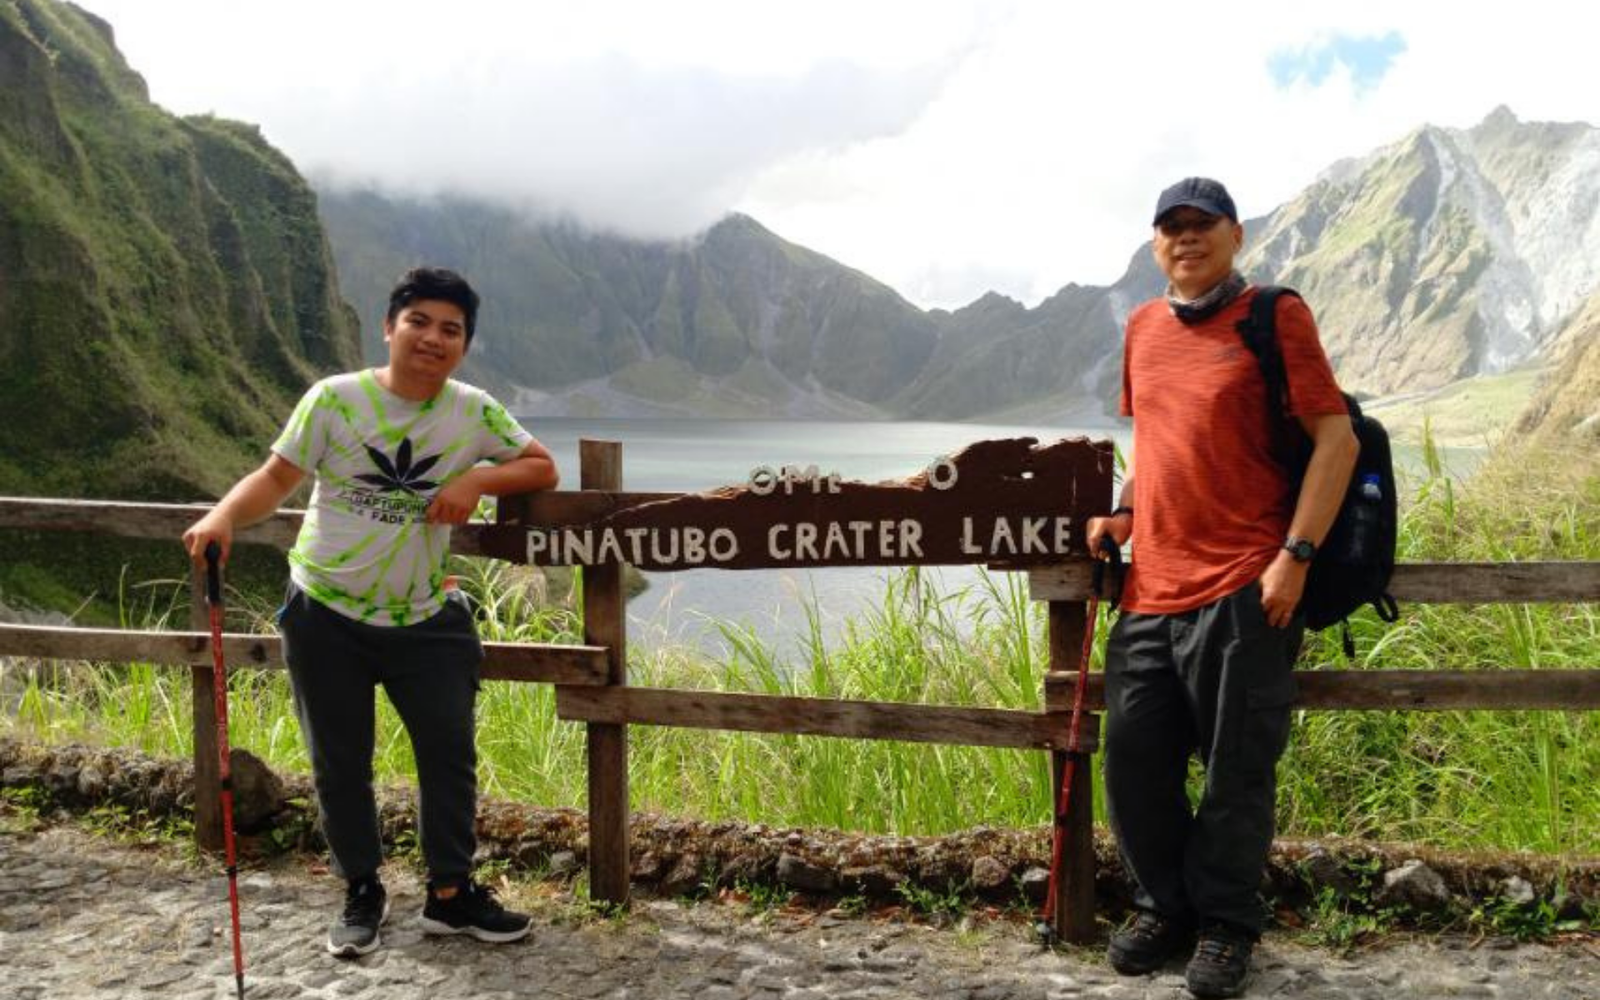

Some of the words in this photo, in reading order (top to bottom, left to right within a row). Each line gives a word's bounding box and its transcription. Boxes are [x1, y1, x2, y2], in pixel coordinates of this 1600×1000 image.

[526, 527, 738, 566] PINATUBO
[767, 518, 925, 560] CRATER
[961, 516, 1072, 555] LAKE
